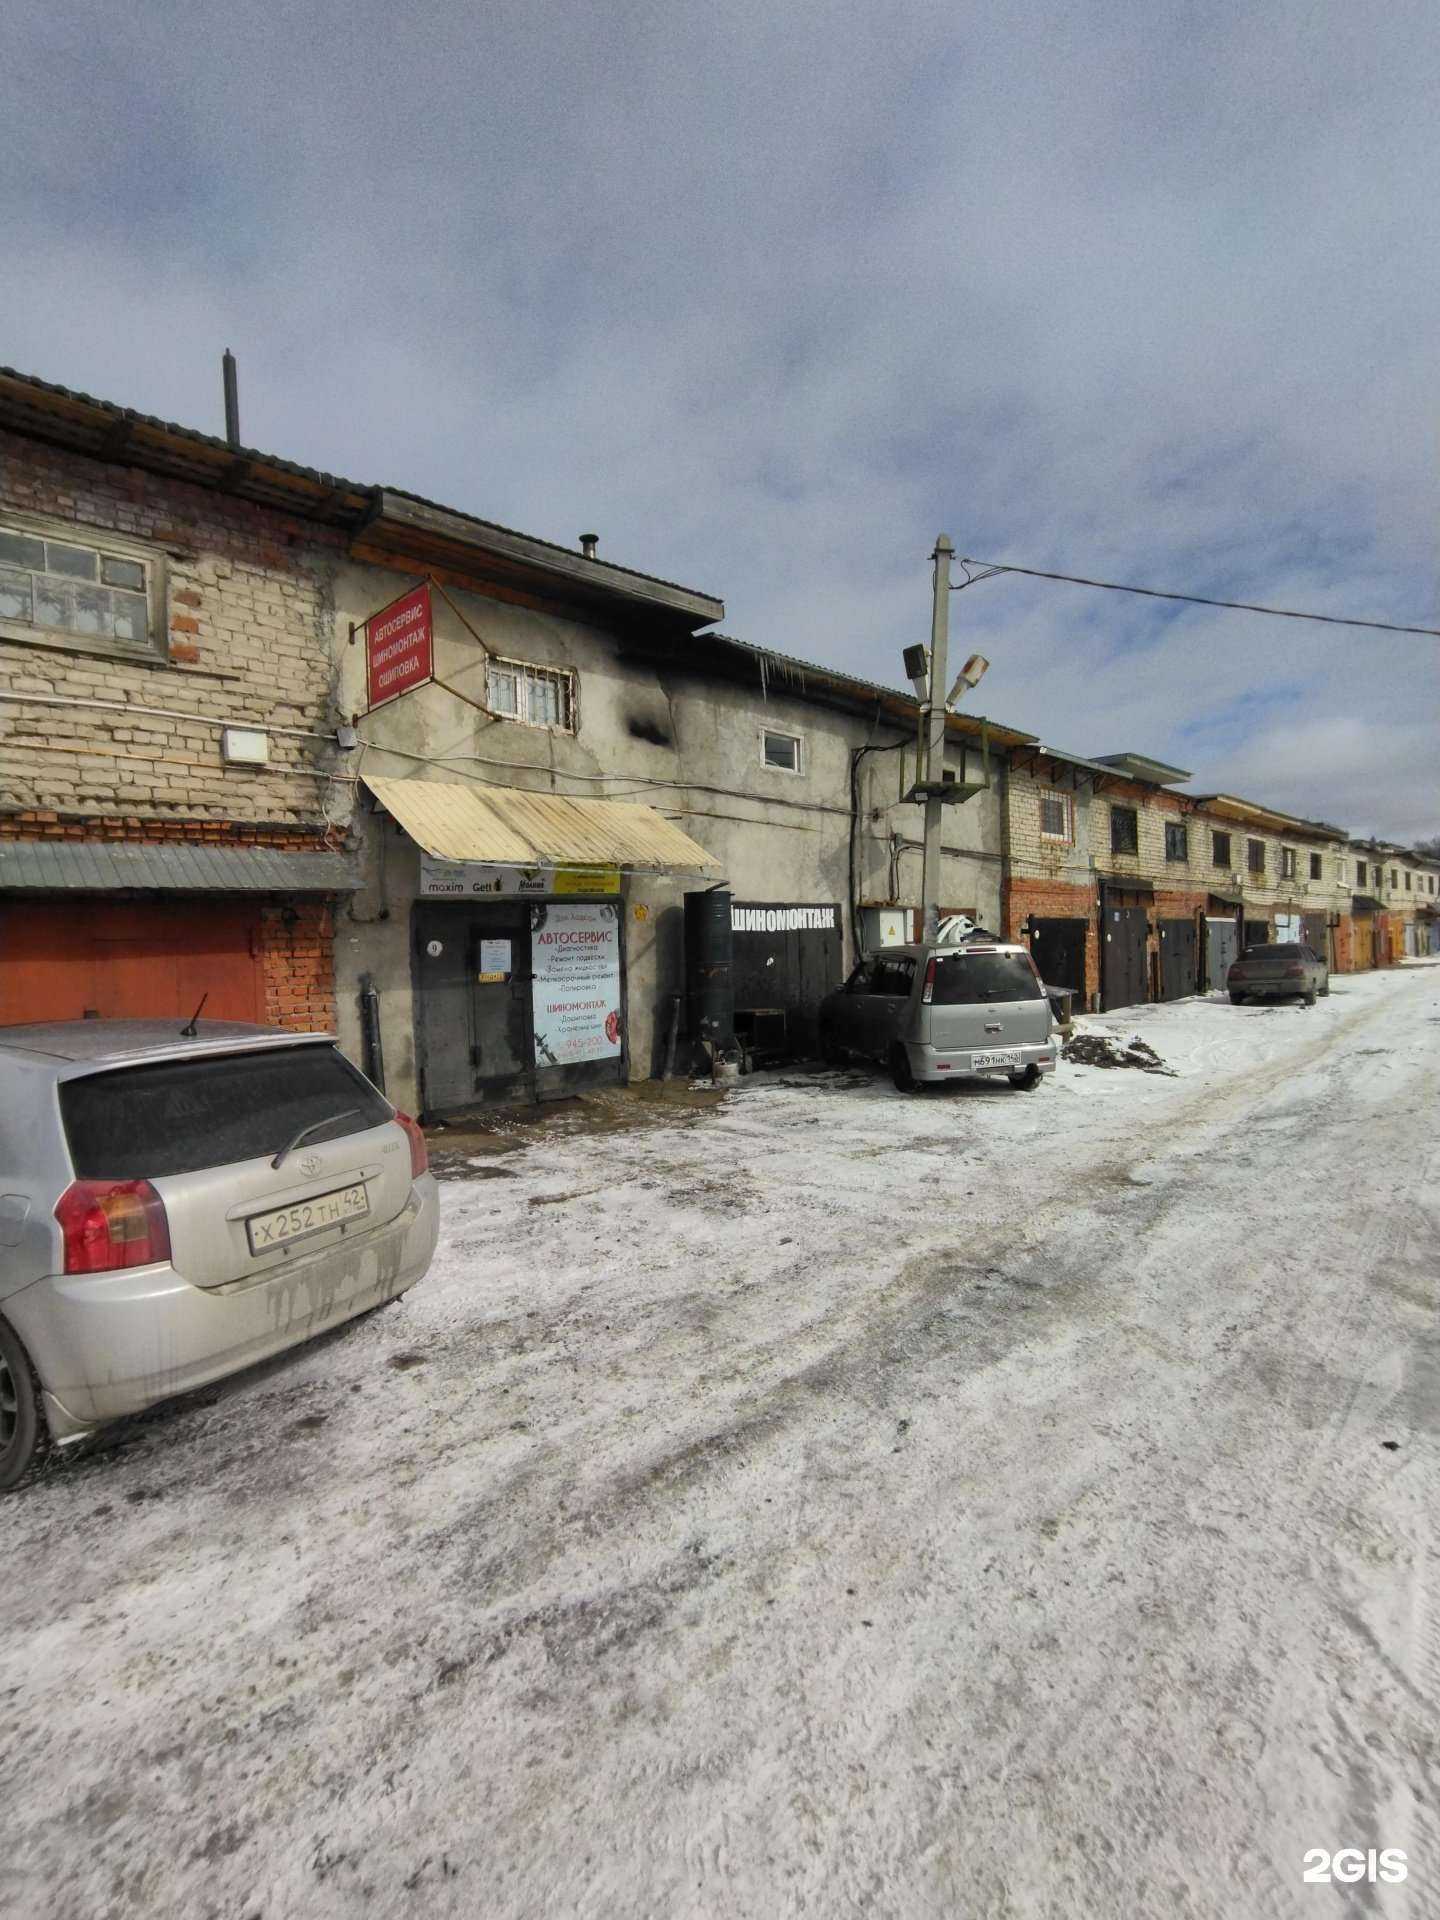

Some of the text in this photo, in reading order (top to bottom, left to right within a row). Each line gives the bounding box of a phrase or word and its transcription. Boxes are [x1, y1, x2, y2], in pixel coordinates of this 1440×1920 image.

[374, 604, 423, 644] АВТОСЕРВИС
[372, 626, 426, 668] ШИНОМОНТАЖ
[428, 883, 464, 892] maxim
[730, 905, 835, 932] ШИНОМОНТАЖ
[537, 931, 613, 944] АВТОСЕРВИС
[547, 1000, 606, 1013] ШИНОМОНТАЖ
